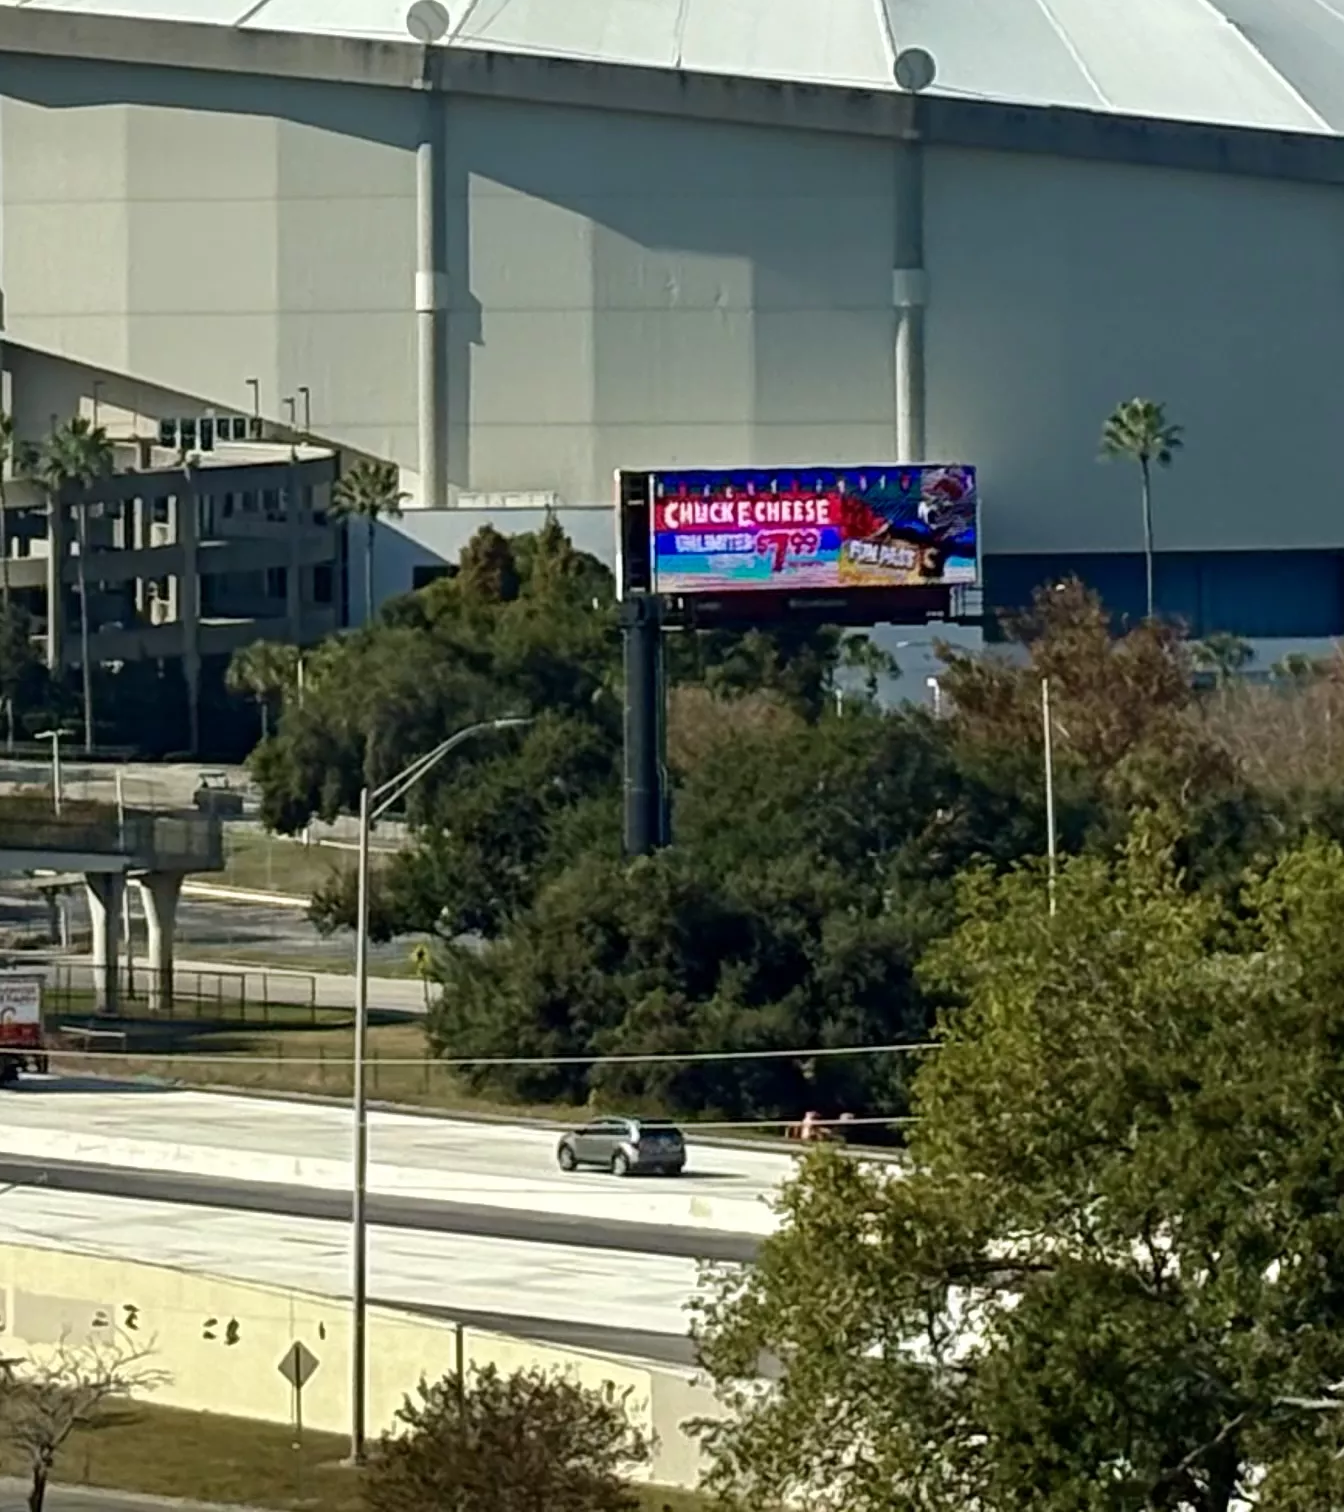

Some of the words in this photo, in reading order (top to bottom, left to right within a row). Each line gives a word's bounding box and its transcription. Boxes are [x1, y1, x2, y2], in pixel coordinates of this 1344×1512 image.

[664, 501, 734, 529] CHUCK
[737, 501, 754, 527] E
[755, 499, 830, 525] CHEESE
